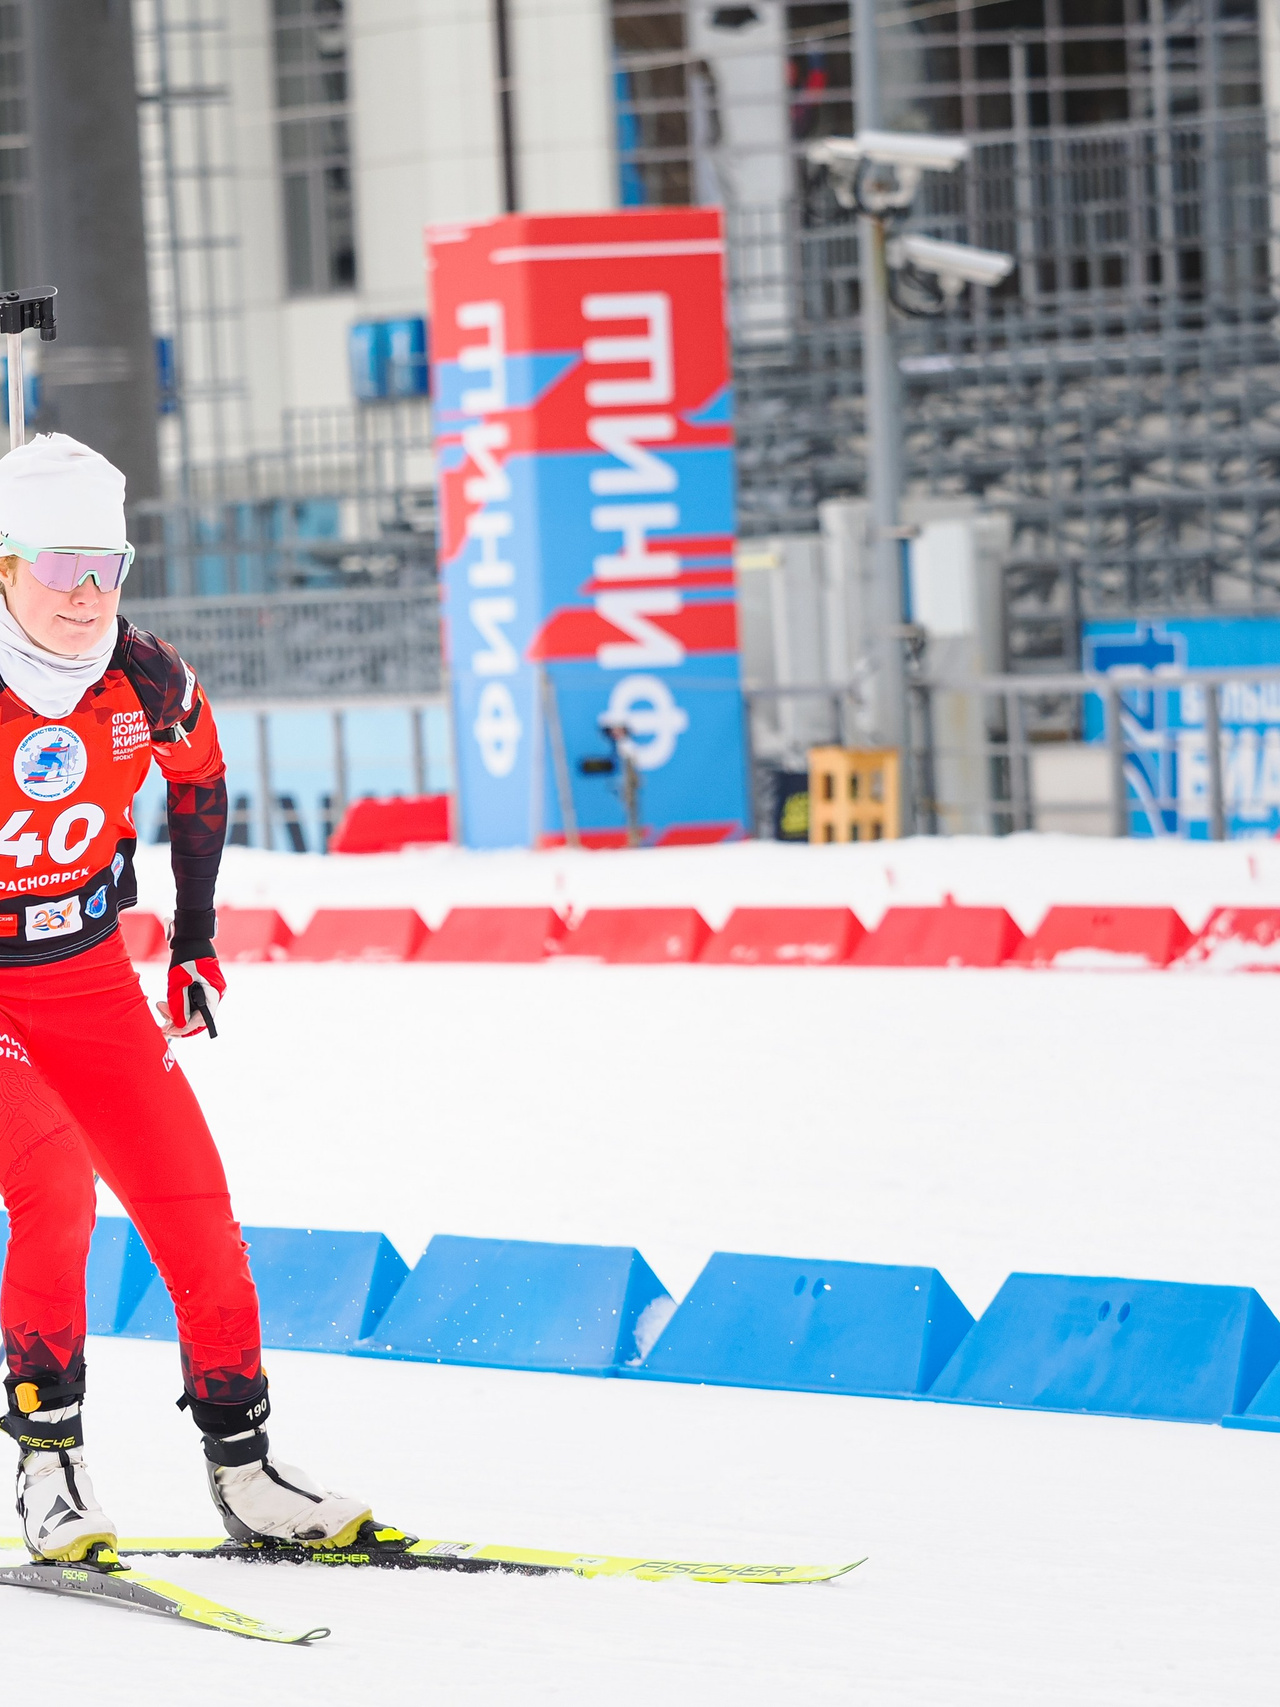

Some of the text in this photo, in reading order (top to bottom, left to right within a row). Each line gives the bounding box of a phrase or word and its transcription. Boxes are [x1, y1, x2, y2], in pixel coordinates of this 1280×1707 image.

[456, 301, 521, 777] ФИНИШ
[582, 292, 689, 771] ФИНИШ
[112, 722, 150, 737] НОРМА
[112, 731, 151, 749] ЖИЗНИ
[245, 1397, 267, 1421] 190
[19, 1434, 76, 1449] FISCHE
[313, 1552, 370, 1564] FISCHER
[61, 1569, 89, 1582] FISCHER
[629, 1561, 796, 1577] FISCHER
